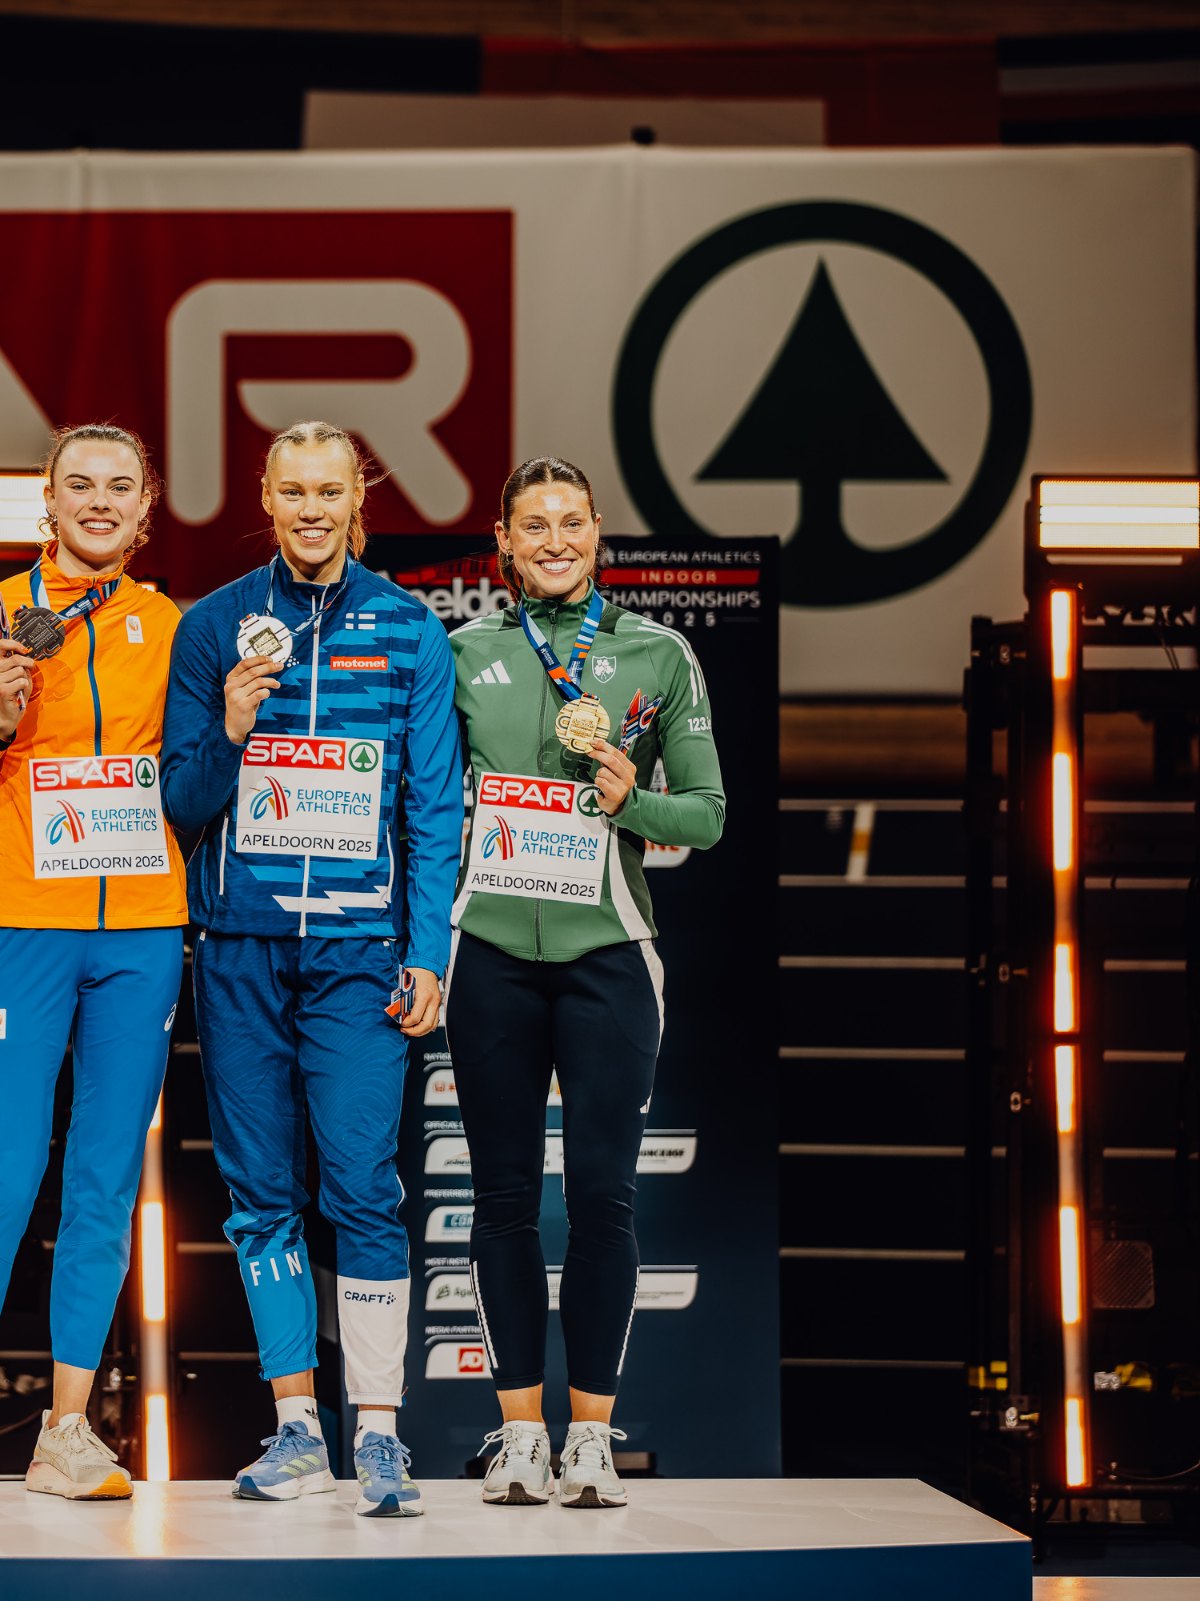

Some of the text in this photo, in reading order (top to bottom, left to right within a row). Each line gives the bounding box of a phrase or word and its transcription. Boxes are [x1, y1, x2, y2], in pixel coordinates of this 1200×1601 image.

[617, 550, 761, 564] EUROPEAN ATHLETICS
[641, 570, 717, 584] INDOOR
[332, 658, 386, 668] motonet
[246, 741, 343, 766] SPAR
[35, 760, 132, 788] SPAR
[297, 788, 372, 804] EUROPEAN
[481, 780, 572, 809] SPAR
[91, 808, 157, 821] EUROPEAN
[296, 800, 371, 816] ATHLETICS
[91, 820, 158, 833] ATHLETICS
[241, 833, 372, 852] APELDOORN 2025
[522, 829, 599, 849] EUROPEAN
[521, 841, 597, 861] ATHLETICS
[40, 855, 165, 872] APELDOORN 2025
[471, 873, 597, 898] APELDOORN 2025
[249, 1250, 303, 1287] FIN
[343, 1290, 387, 1304] CRAFT
